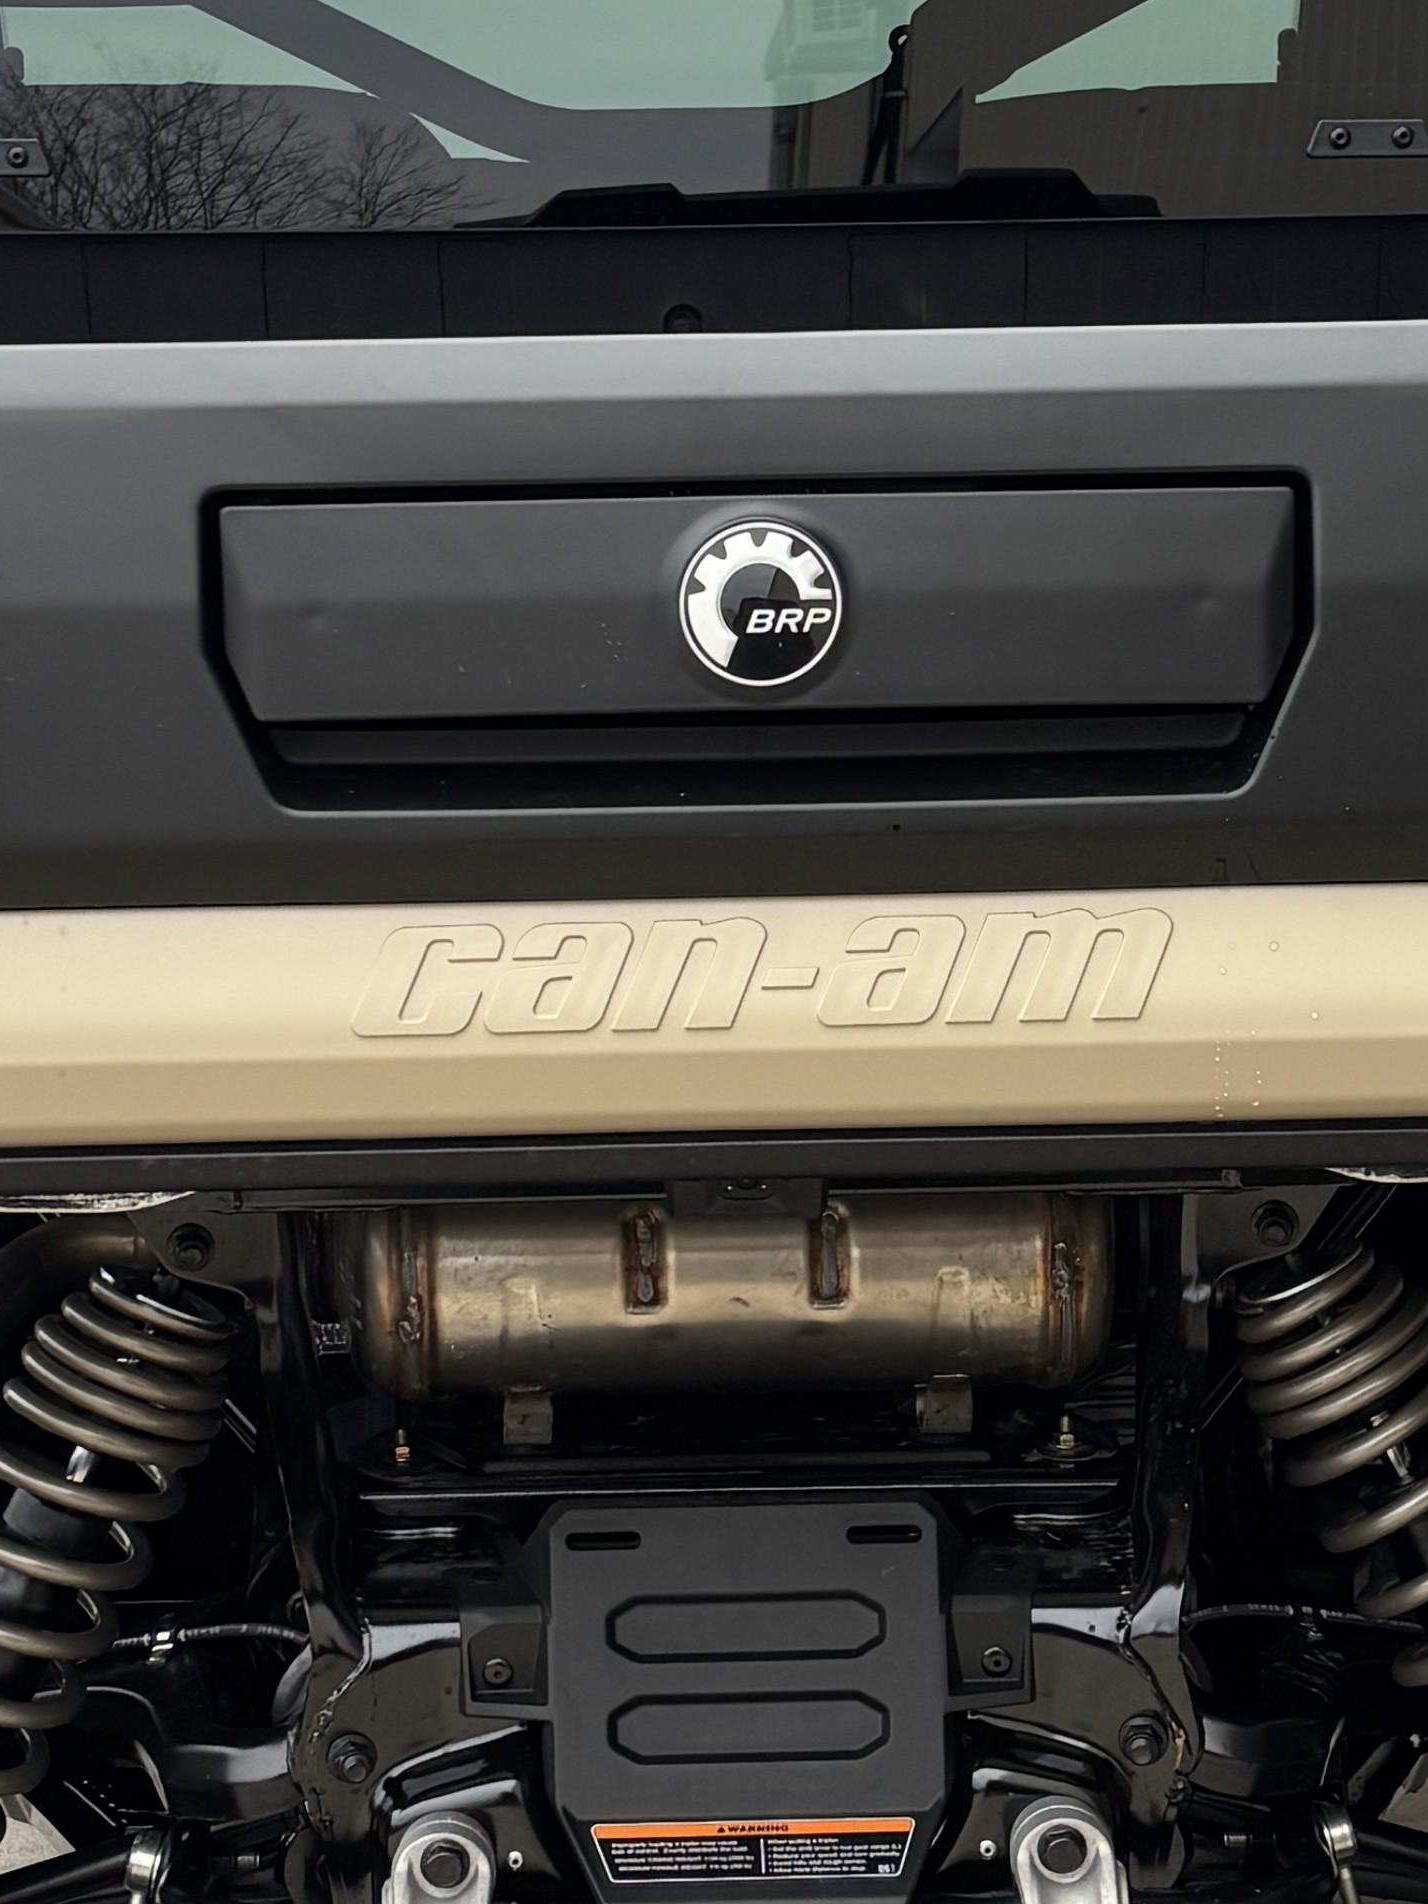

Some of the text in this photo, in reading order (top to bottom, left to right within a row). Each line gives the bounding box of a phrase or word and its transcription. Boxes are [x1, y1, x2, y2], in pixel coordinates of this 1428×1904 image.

[745, 607, 832, 634] BRP
[351, 906, 1173, 1037] can-am
[728, 1824, 789, 1833] WARNING
